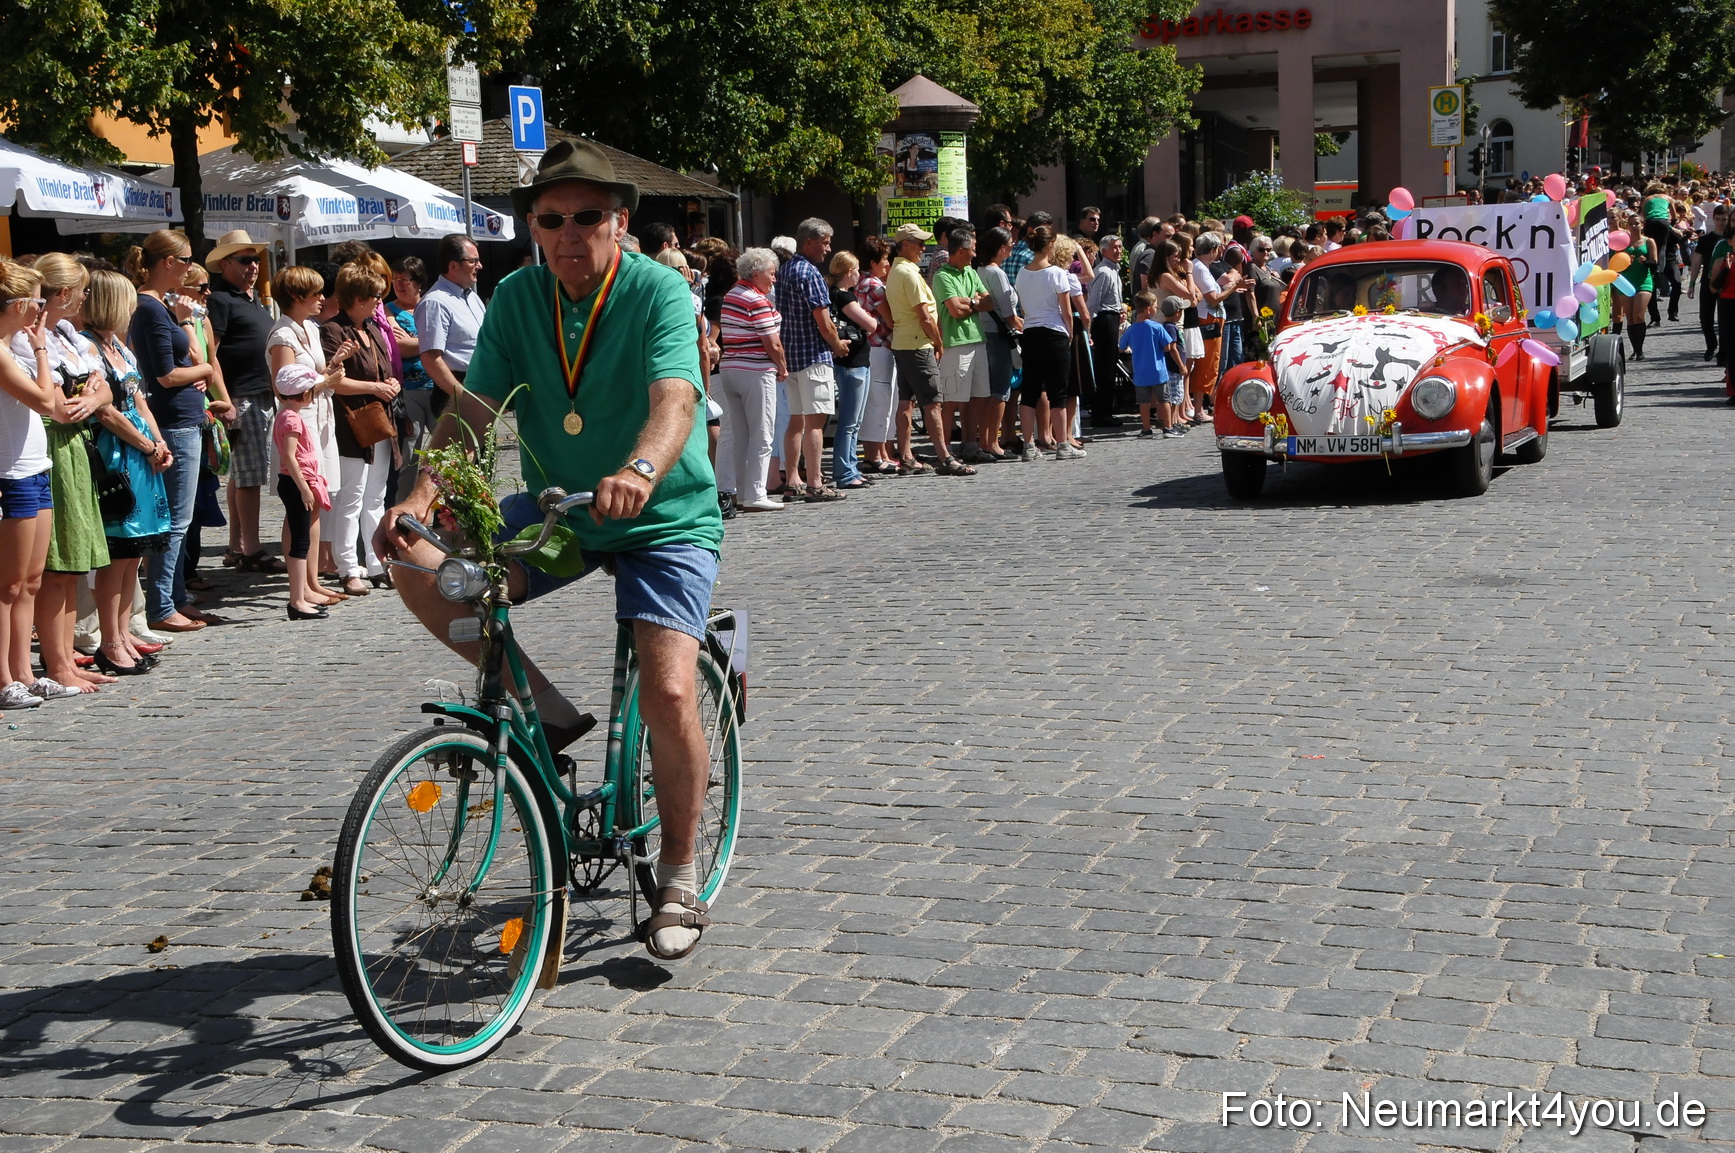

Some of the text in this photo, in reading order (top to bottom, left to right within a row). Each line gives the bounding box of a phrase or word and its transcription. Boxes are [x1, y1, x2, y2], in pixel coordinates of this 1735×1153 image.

[1139, 8, 1313, 44] Sparkasse
[1440, 96, 1453, 109] H
[518, 95, 536, 142] P
[36, 177, 95, 201] Winkler Bräu
[123, 186, 164, 209] Winkler Bräu
[246, 194, 274, 213] Bräu
[316, 197, 385, 215] Winkler Bräu
[888, 208, 943, 217] VOLKSFEST
[904, 200, 925, 208] Berlin
[425, 202, 485, 228] Winkler Bäu
[1296, 438, 1317, 453] NM
[1327, 438, 1347, 453] VW
[1350, 438, 1380, 453] 58H
